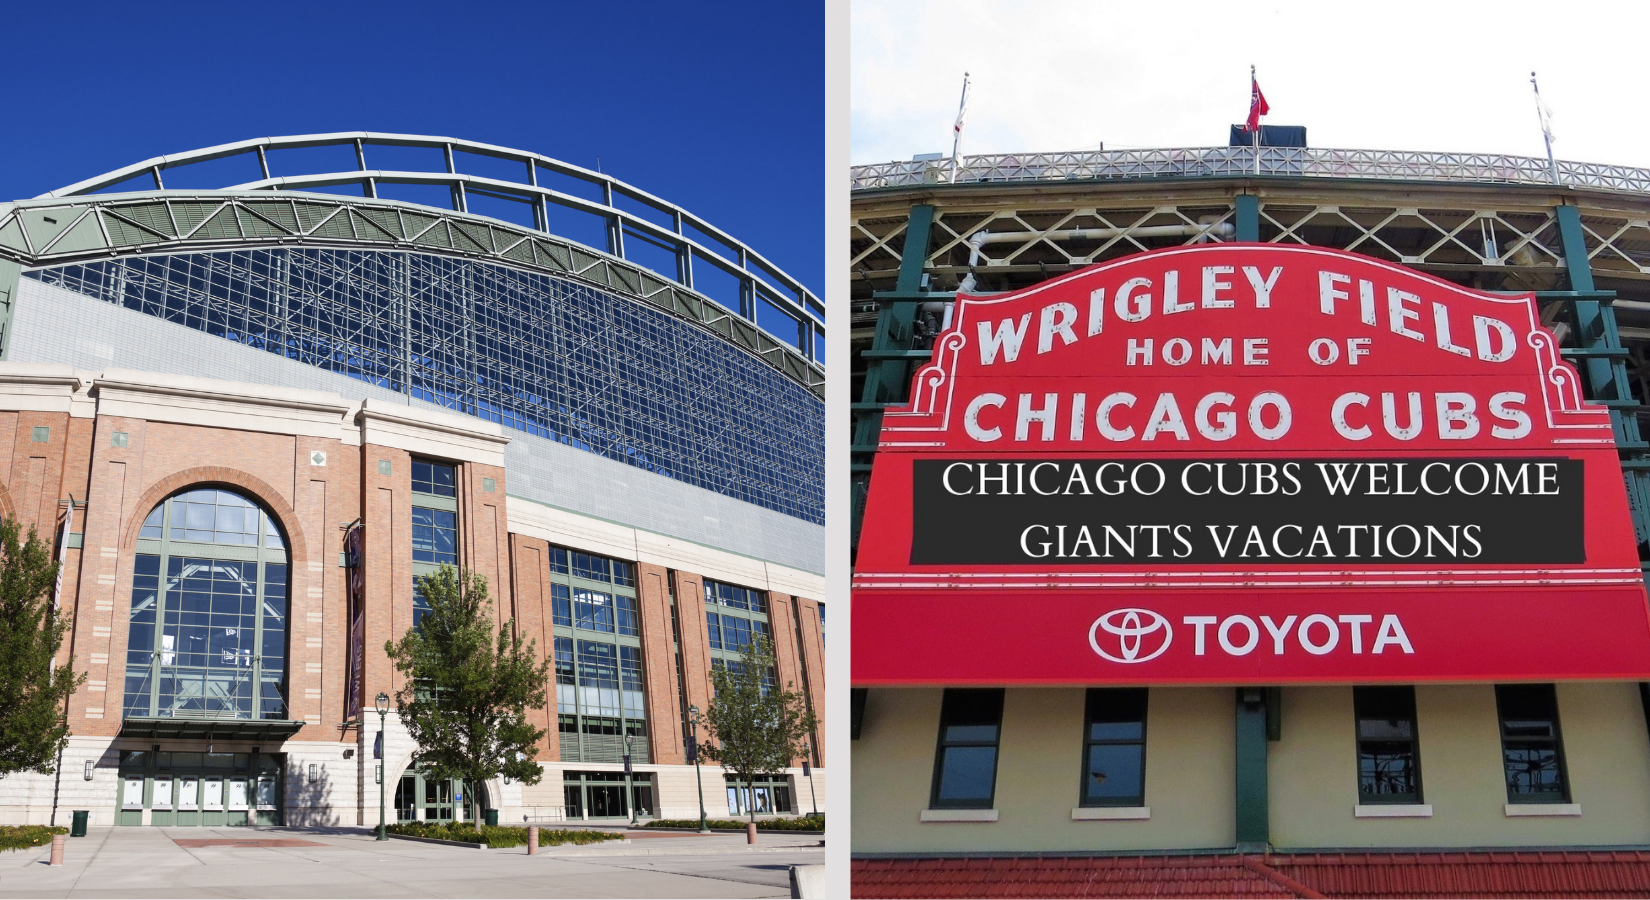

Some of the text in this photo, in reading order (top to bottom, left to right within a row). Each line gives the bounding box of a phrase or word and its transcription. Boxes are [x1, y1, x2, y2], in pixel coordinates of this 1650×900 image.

[976, 266, 1517, 366] WRIGLEY FIELD
[1126, 337, 1372, 366] HOME OF
[964, 391, 1532, 443] CHICAGO CUBS
[1183, 613, 1415, 656] TOYOTA
